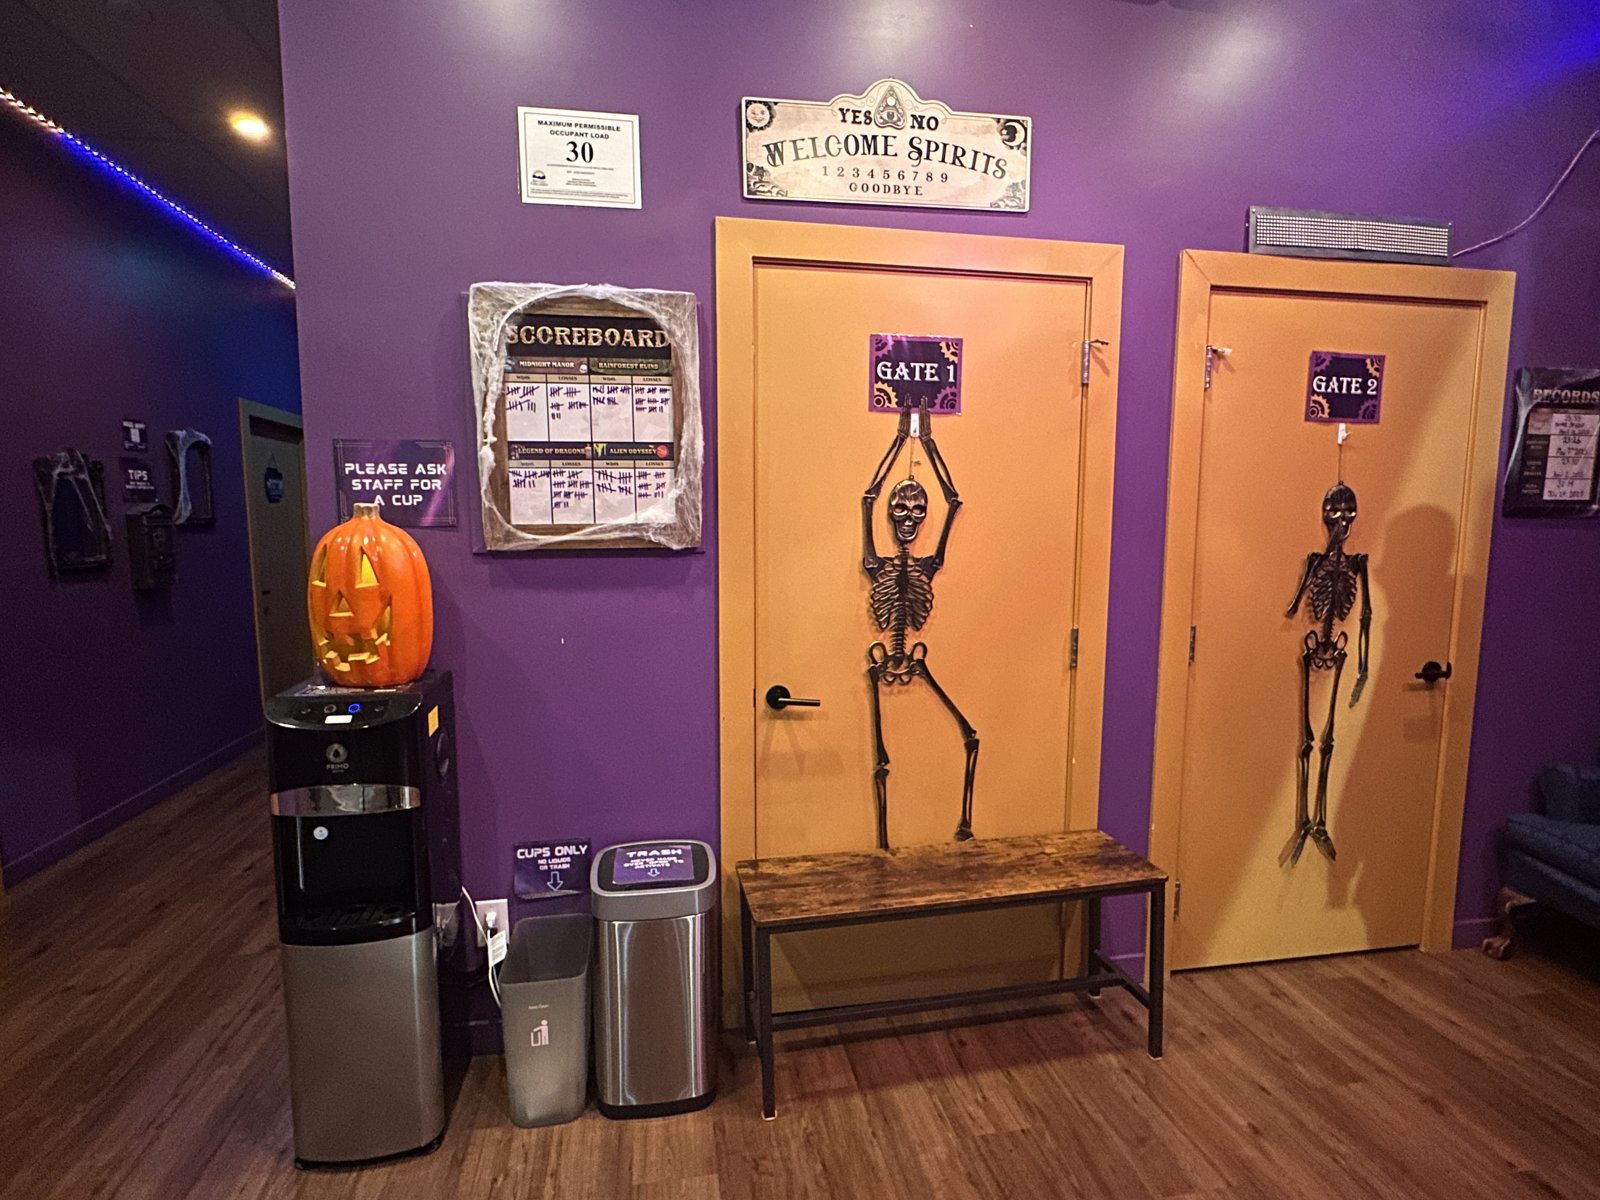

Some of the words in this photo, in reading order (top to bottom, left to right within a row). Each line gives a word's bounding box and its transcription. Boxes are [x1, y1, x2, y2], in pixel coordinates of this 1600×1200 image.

[538, 120, 573, 128] MAXIMUM
[575, 123, 621, 132] PERMISSIBLE
[838, 107, 873, 124] YES
[909, 113, 939, 131] NO
[549, 129, 588, 138] OCCUPANT
[565, 140, 594, 163] 30
[762, 134, 898, 167] WELCOME
[907, 136, 1008, 180] SPIRITS
[849, 182, 923, 196] GOODBYE
[504, 325, 672, 348] SCOREBOARD
[876, 361, 940, 382] GATE
[946, 364, 955, 382] 1
[1312, 375, 1363, 395] GATE
[1366, 378, 1378, 395] 2
[128, 470, 148, 481] TIPS
[344, 463, 408, 475] PLEASE
[415, 463, 447, 475] ASK
[352, 479, 404, 490] STAFF
[410, 479, 442, 490] FOR
[374, 495, 385, 506] A
[391, 494, 423, 506] CUP
[516, 847, 550, 859] CUPS
[554, 845, 588, 856] ONLY
[626, 848, 682, 858] TRASH
